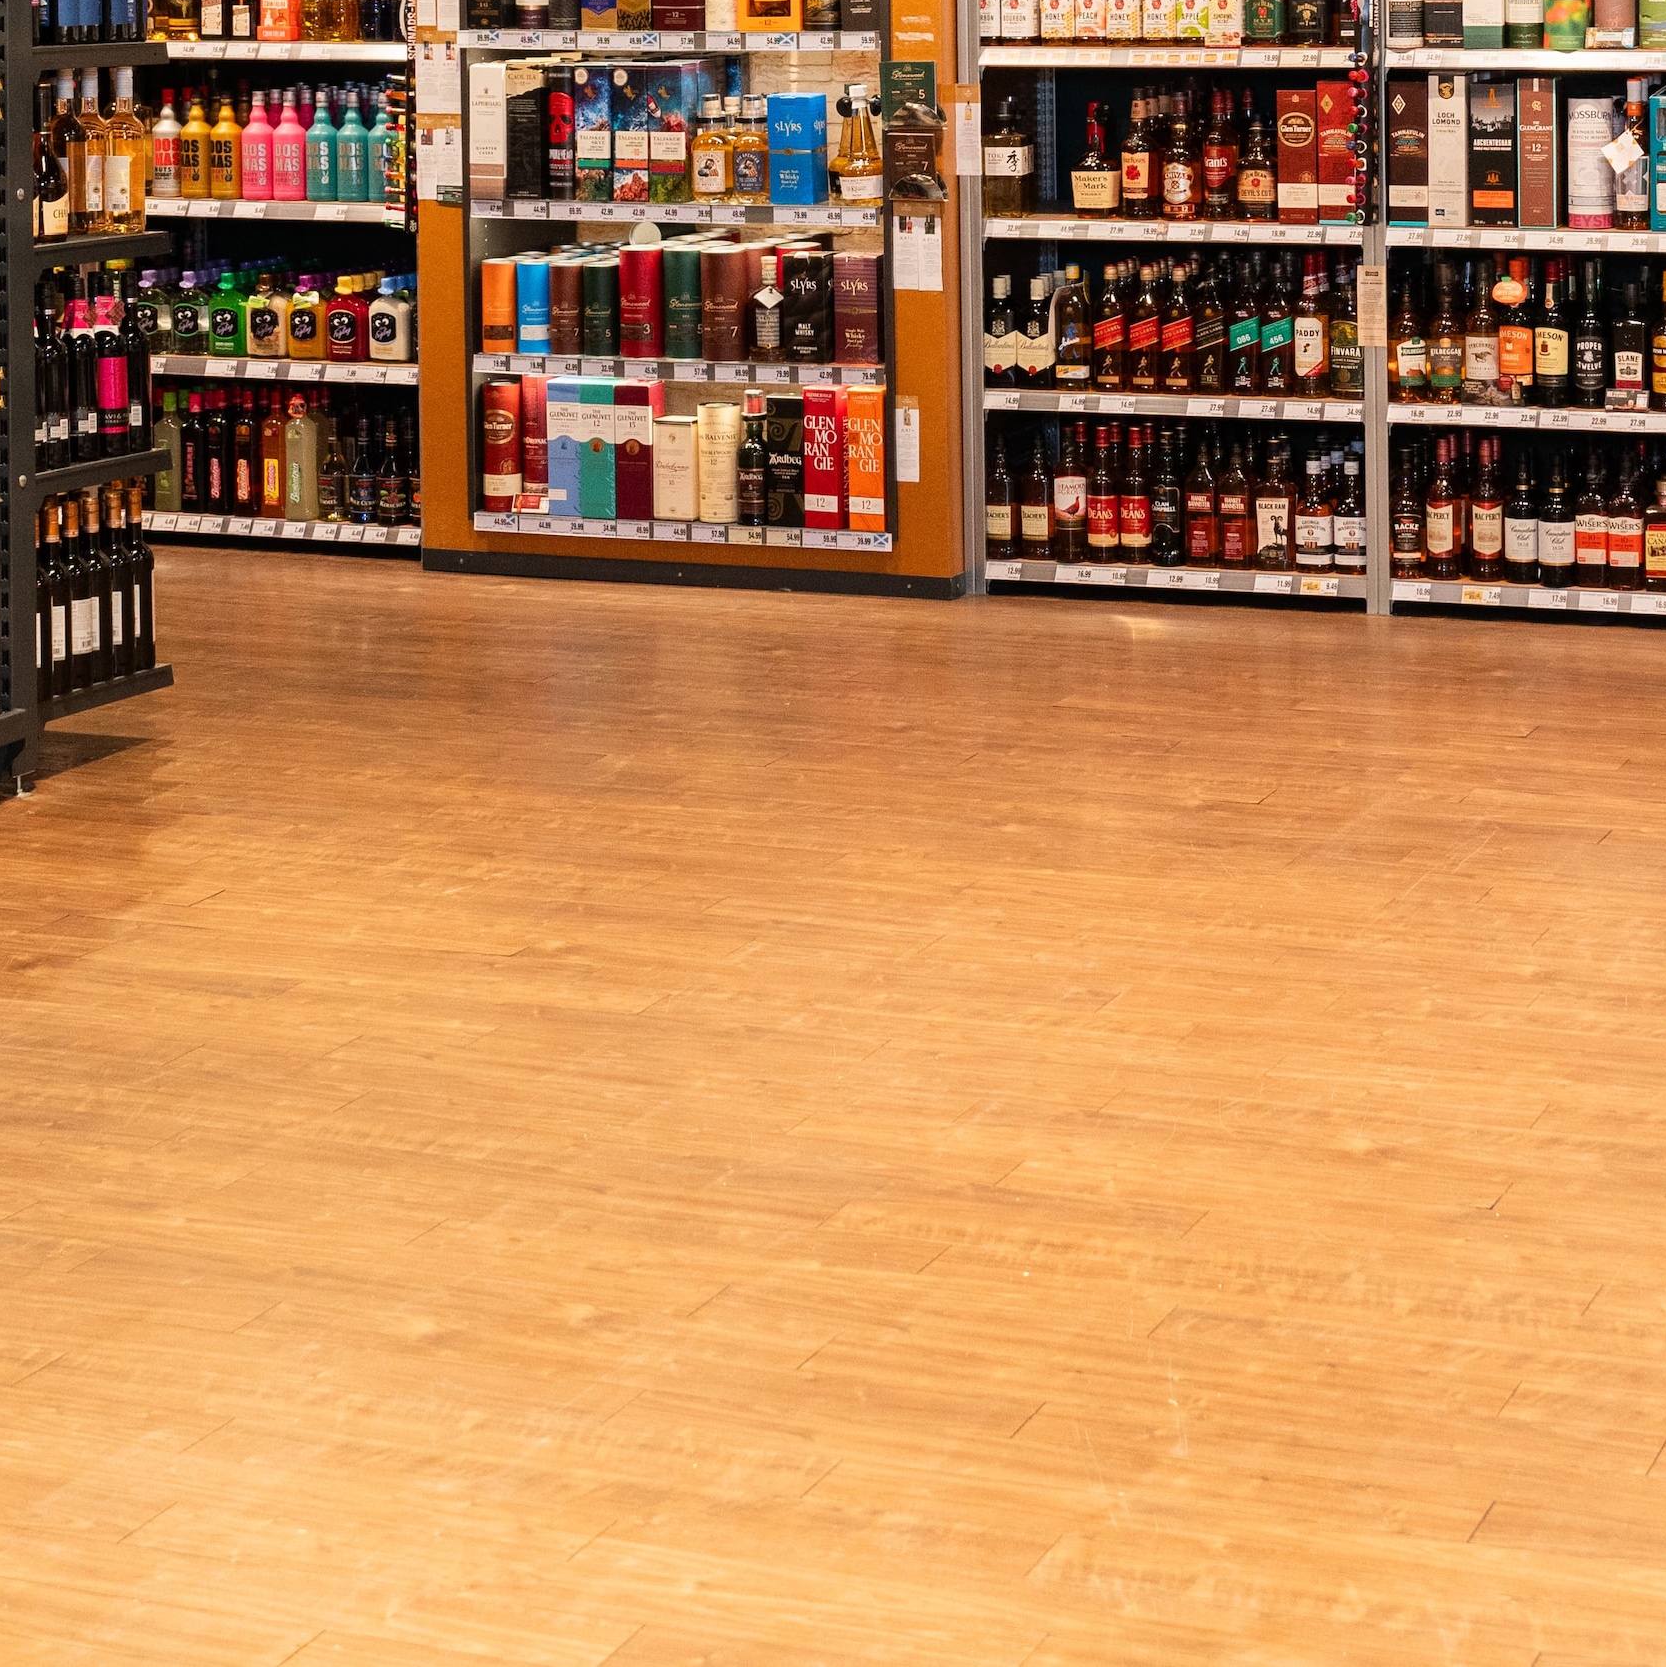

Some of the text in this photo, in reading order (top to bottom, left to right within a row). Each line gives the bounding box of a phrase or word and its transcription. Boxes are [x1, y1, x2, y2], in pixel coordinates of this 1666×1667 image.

[1078, 10, 1098, 20] PEACH
[1181, 11, 1200, 20] APPLE
[918, 88, 925, 99] 5
[153, 139, 179, 153] DOS
[154, 153, 179, 165] MAS
[922, 161, 928, 170] 7
[1075, 176, 1107, 184] Maker's
[644, 324, 650, 334] 3
[731, 326, 738, 338] 7
[1270, 334, 1284, 344] 456
[1330, 346, 1360, 356] FINVARA
[694, 368, 707, 376] 57.99
[804, 414, 835, 430] GLEN
[848, 418, 880, 432] GLEN
[815, 430, 837, 444] MO
[859, 432, 882, 446] MO
[804, 442, 829, 456] RAN
[848, 444, 873, 458] RAN
[770, 454, 801, 464] Ardbeg
[814, 456, 834, 470] GIE
[859, 458, 880, 472] GIE
[816, 498, 825, 507] 12
[862, 500, 870, 509] 12
